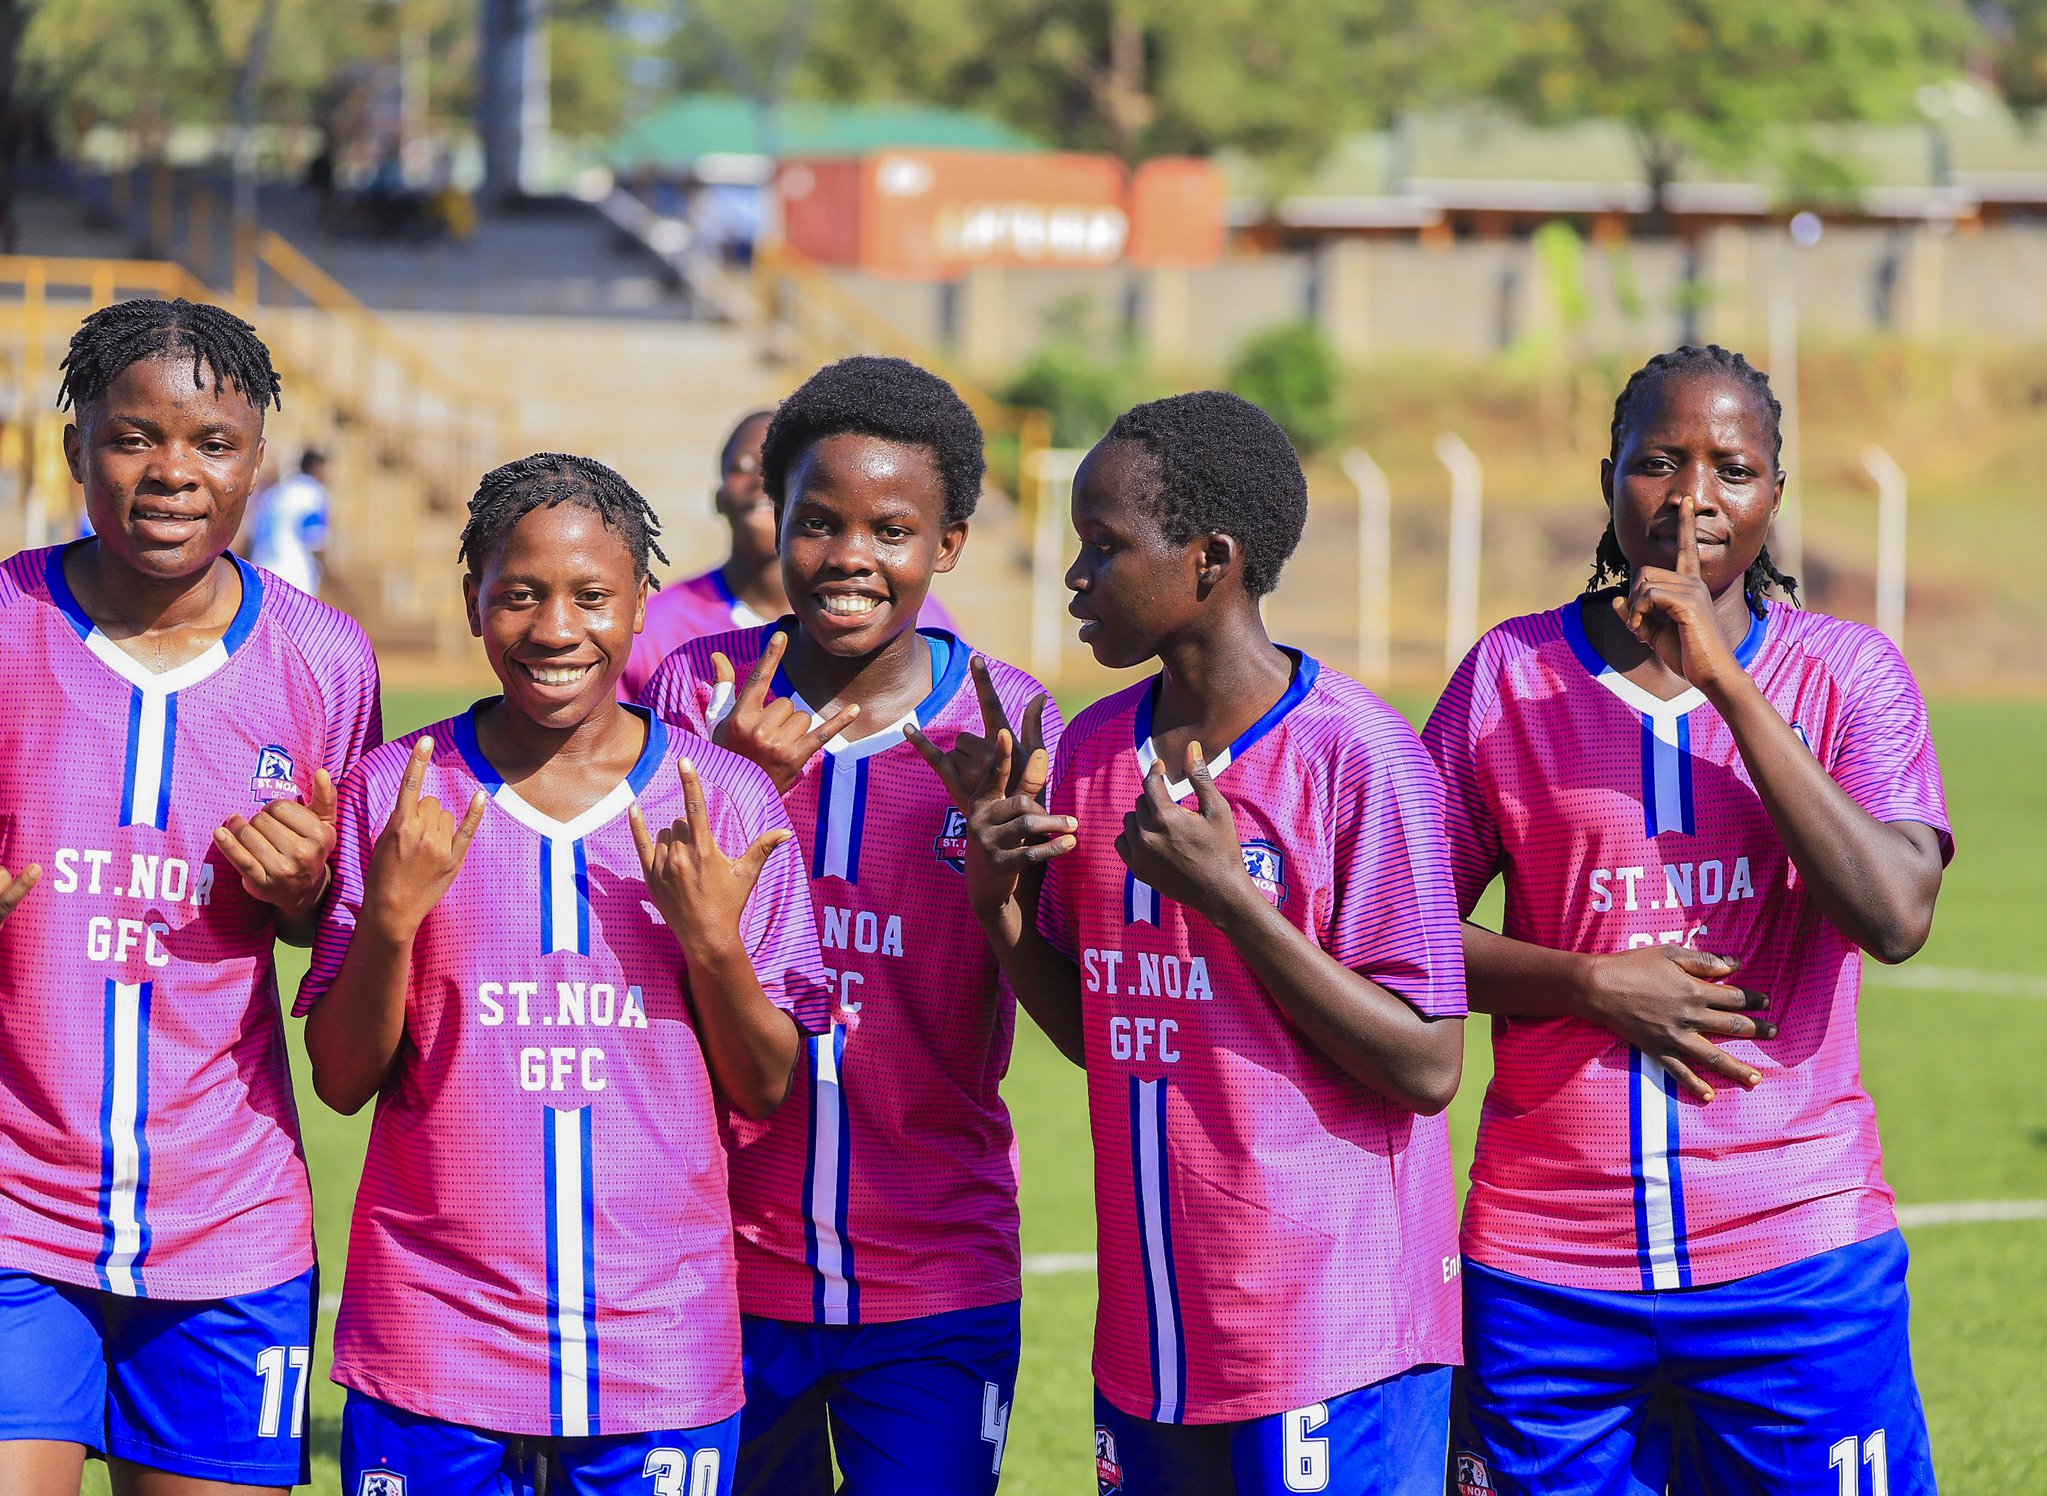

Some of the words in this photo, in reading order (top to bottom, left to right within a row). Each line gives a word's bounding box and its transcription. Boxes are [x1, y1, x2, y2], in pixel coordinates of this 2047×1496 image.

[275, 780, 298, 794] NOA
[54, 847, 215, 906] ST.NOA
[1588, 856, 1754, 912] ST.NOA
[87, 916, 170, 967] GFC
[822, 905, 904, 957] NOA
[1083, 948, 1214, 1001] ST.NOA
[478, 981, 648, 1029] ST.NOA
[1109, 1016, 1181, 1063] GFC
[519, 1047, 607, 1092] GFC
[256, 1346, 310, 1438] 17
[642, 1447, 720, 1496] 30
[1282, 1402, 1329, 1493] 6
[1828, 1427, 1890, 1496] 11
[1467, 1486, 1488, 1496] NOA
